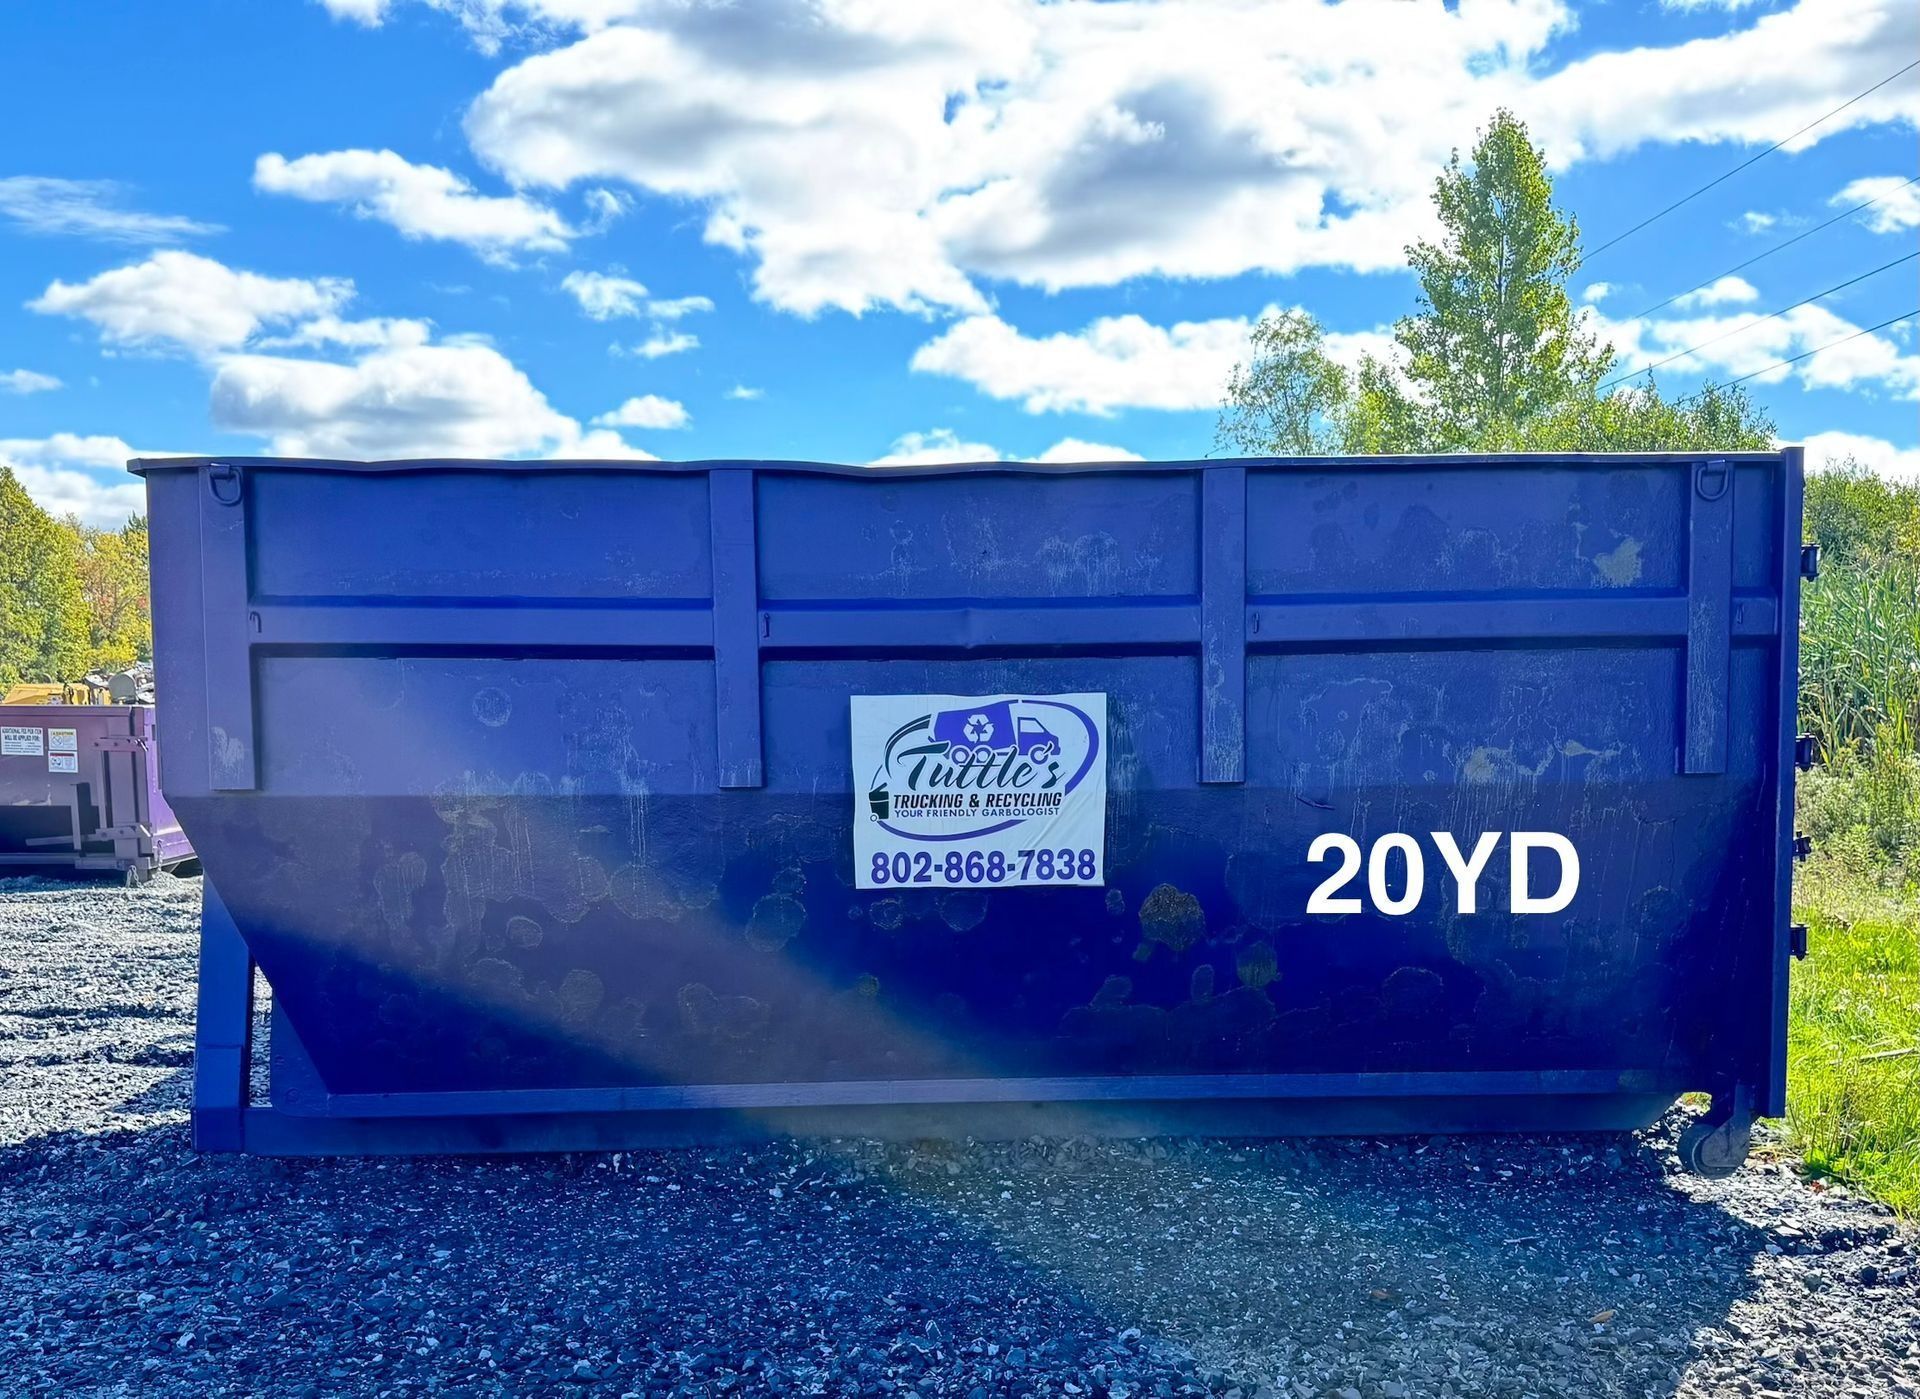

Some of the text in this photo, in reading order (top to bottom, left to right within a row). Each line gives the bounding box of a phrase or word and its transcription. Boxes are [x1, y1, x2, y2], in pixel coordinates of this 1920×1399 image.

[897, 742, 1065, 791] Tuttle's
[894, 792, 1062, 809] TRUCKING & RECYCLING
[894, 808, 1059, 818] YOUR FRIENDLY GARBOLOGIST
[871, 848, 1096, 884] 802-868-7838
